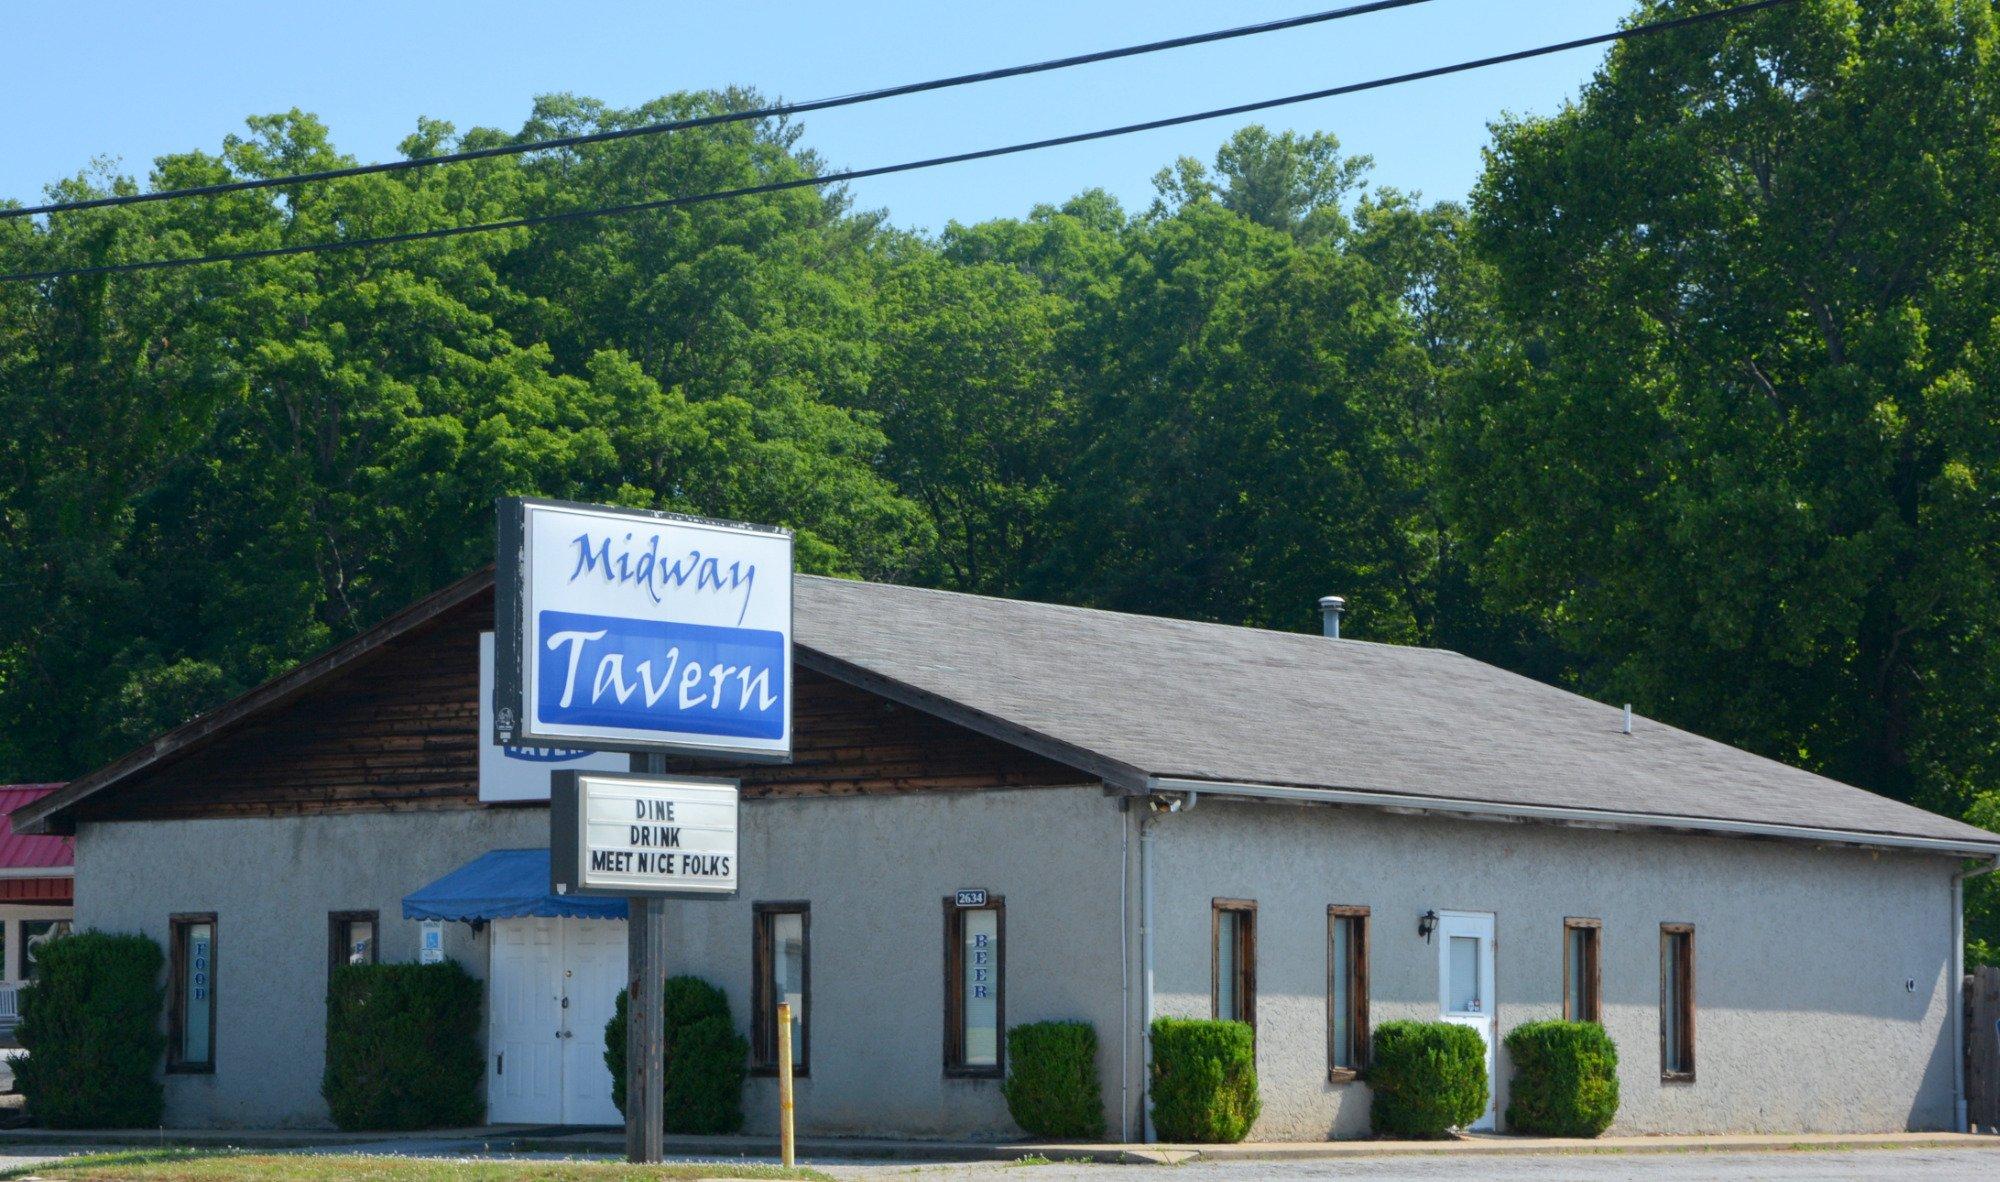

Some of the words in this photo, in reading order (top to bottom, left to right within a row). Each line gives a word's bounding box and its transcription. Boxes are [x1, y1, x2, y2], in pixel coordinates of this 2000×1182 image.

[570, 533, 756, 626] Midway
[546, 629, 778, 711] Tavern
[636, 799, 675, 821] DINE
[630, 825, 680, 847] DRINK
[592, 850, 633, 872] MEET
[638, 852, 675, 874] NICE
[683, 854, 730, 876] FOLKS
[958, 893, 983, 904] 2634
[194, 942, 207, 1000] FOOD
[974, 934, 988, 998] BEER
